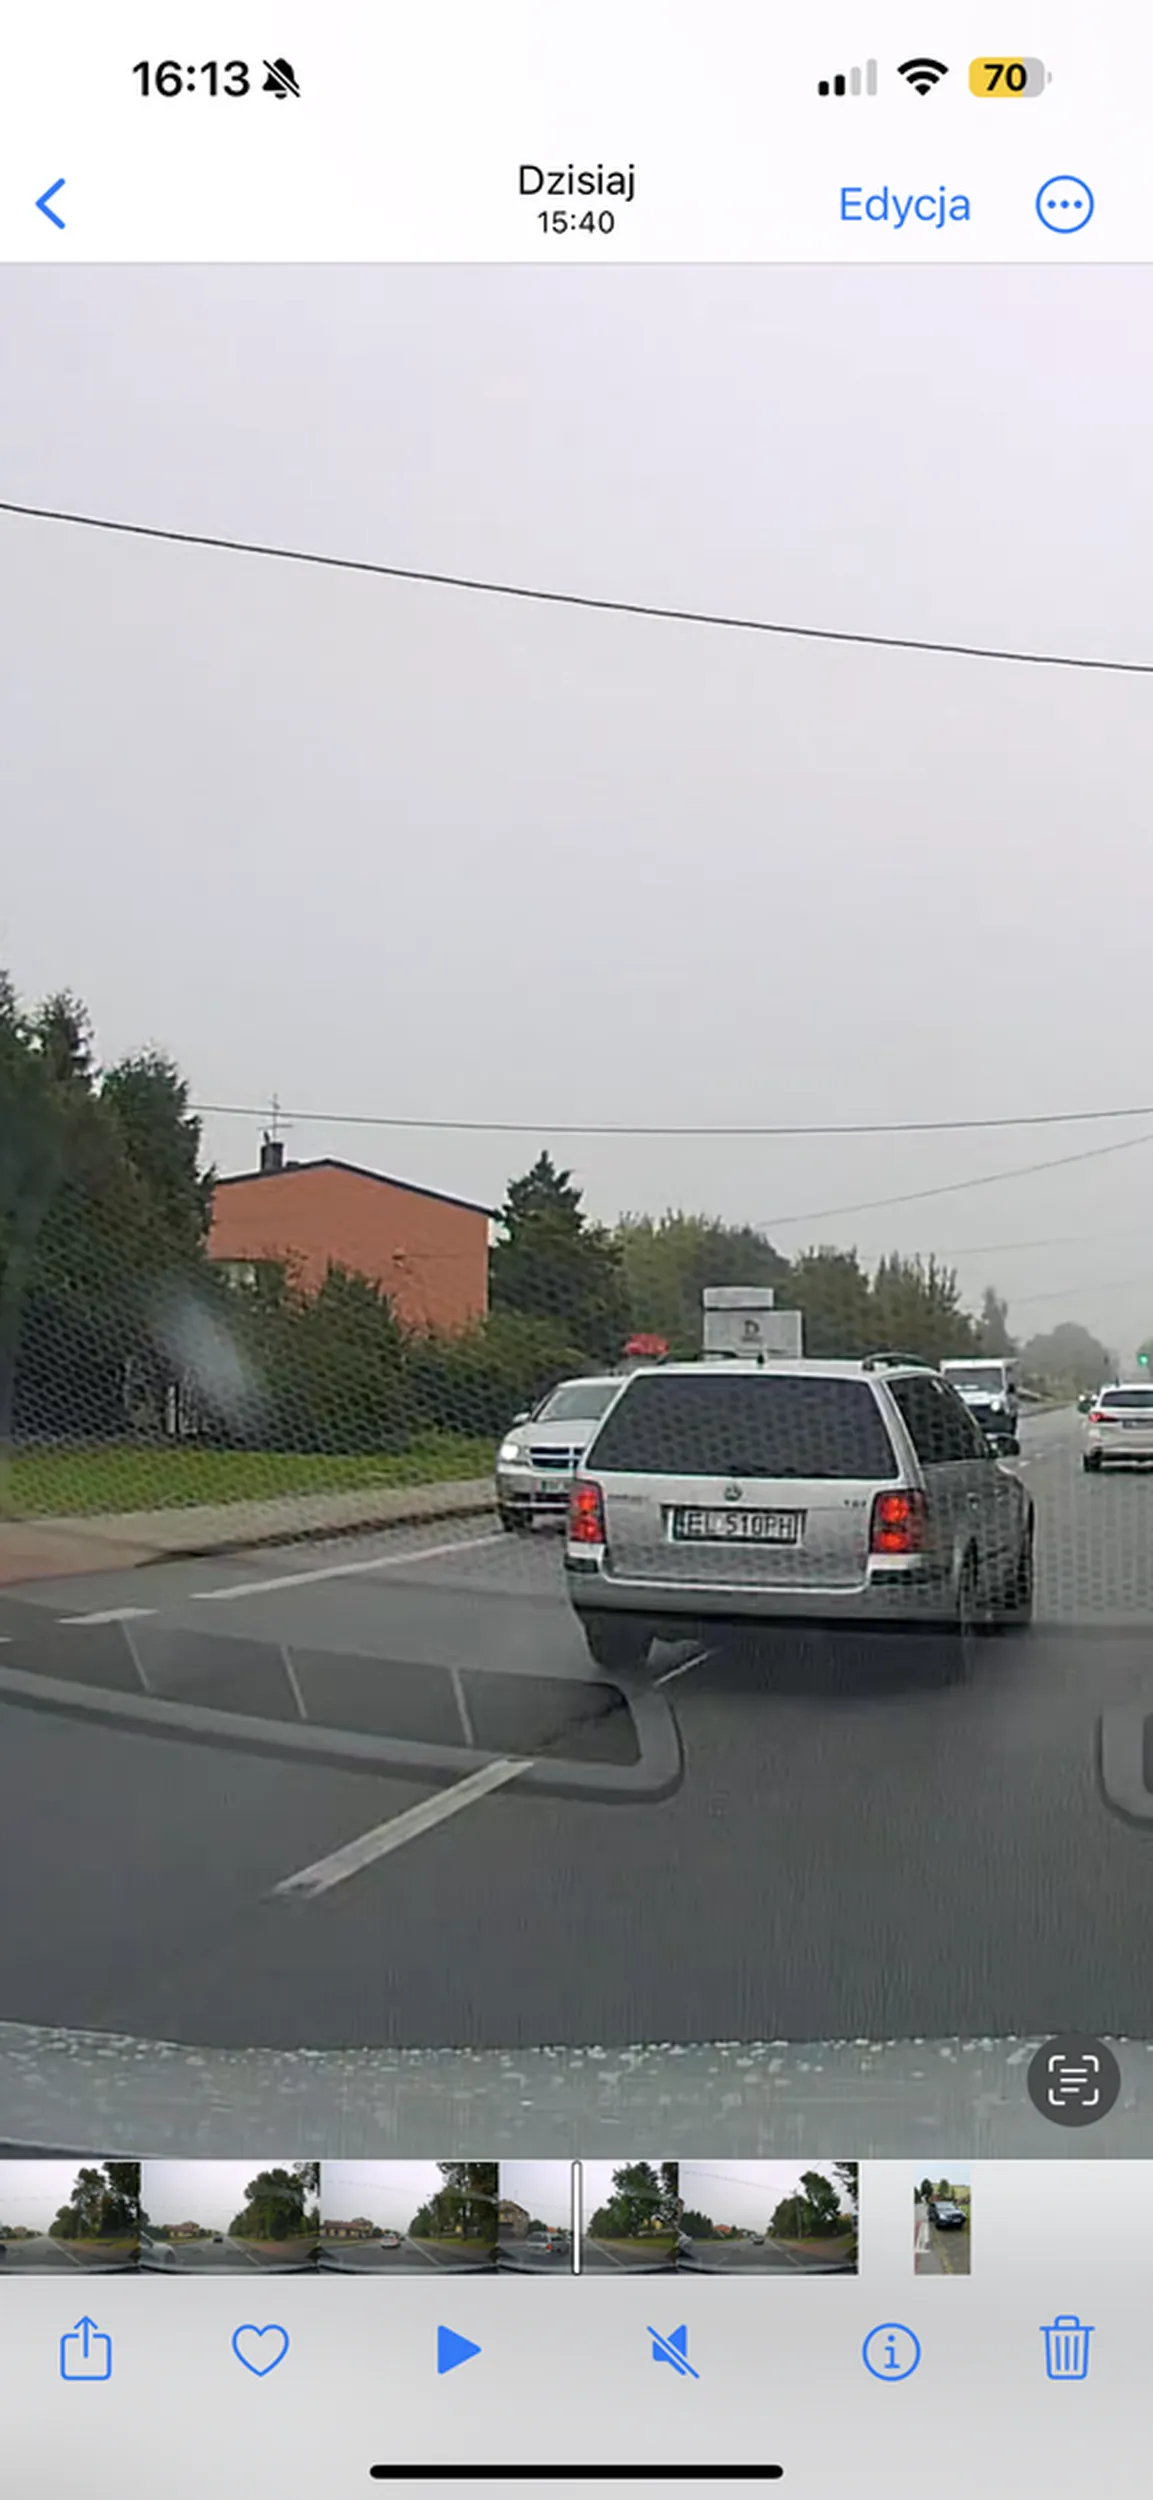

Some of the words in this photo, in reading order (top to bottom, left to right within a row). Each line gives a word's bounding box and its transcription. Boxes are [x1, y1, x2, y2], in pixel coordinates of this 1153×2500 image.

[131, 59, 251, 98] 16:13
[984, 63, 1027, 92] 70
[518, 163, 636, 203] Dzisiaj
[537, 209, 615, 235] 15:40
[840, 184, 971, 230] Edycja
[687, 1512, 715, 1534] EL
